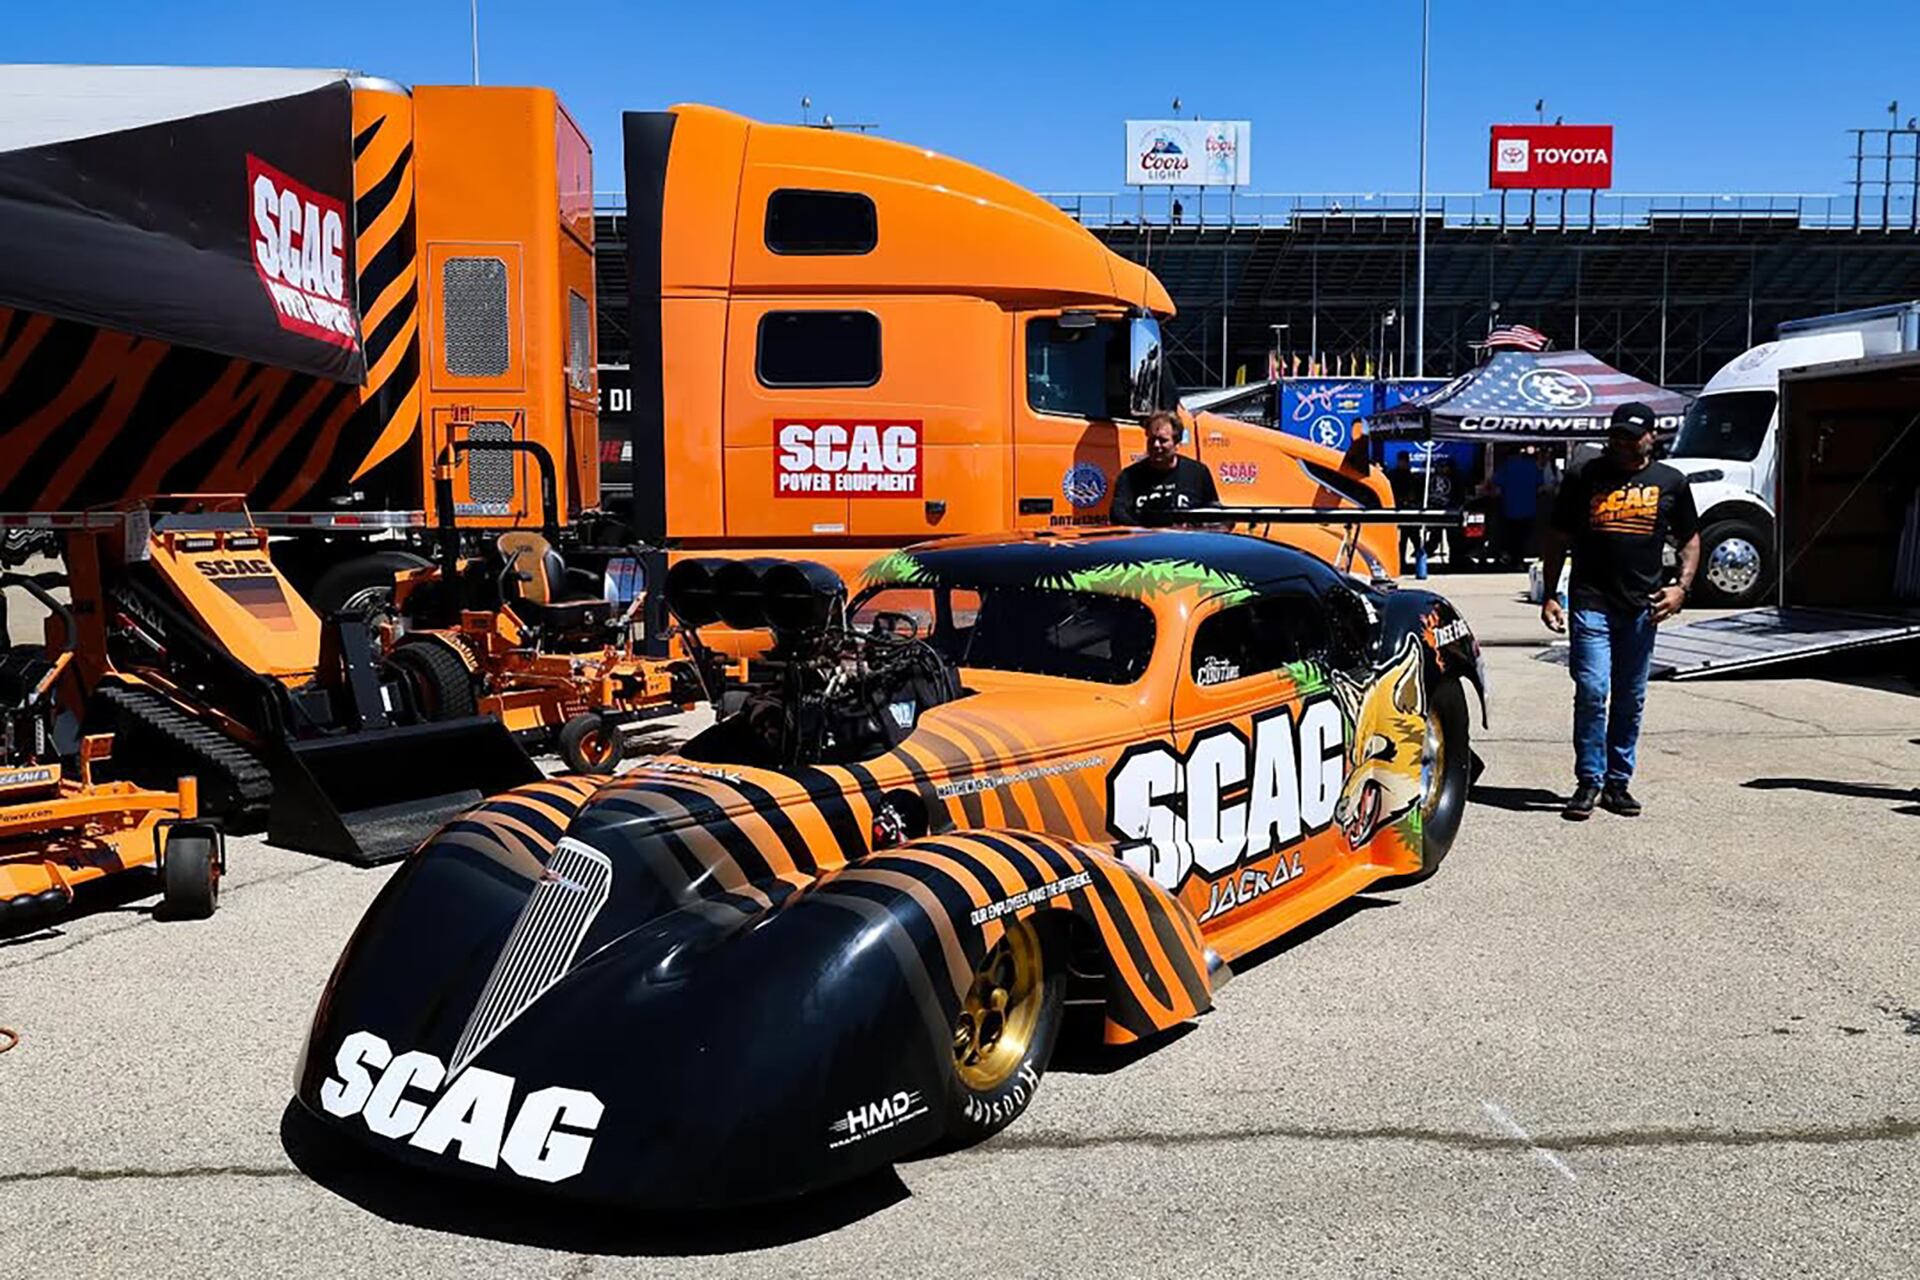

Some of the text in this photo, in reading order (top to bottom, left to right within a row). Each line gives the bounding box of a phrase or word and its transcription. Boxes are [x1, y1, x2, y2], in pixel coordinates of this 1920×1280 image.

[1140, 152, 1189, 170] Coors
[1534, 148, 1608, 164] TOYOTA
[1148, 171, 1182, 180] LIGHT
[254, 174, 343, 300] SCAG
[779, 424, 917, 472] SCAG
[1220, 462, 1256, 477] SCAG
[780, 473, 916, 492] POWER EQUIPMENT
[195, 559, 273, 577] SCAG
[1108, 696, 1346, 894] SCAG
[1199, 852, 1304, 924] JACKAL
[970, 907, 989, 925] OUR
[320, 1030, 605, 1183] SCAG
[847, 1091, 910, 1133] HMD
